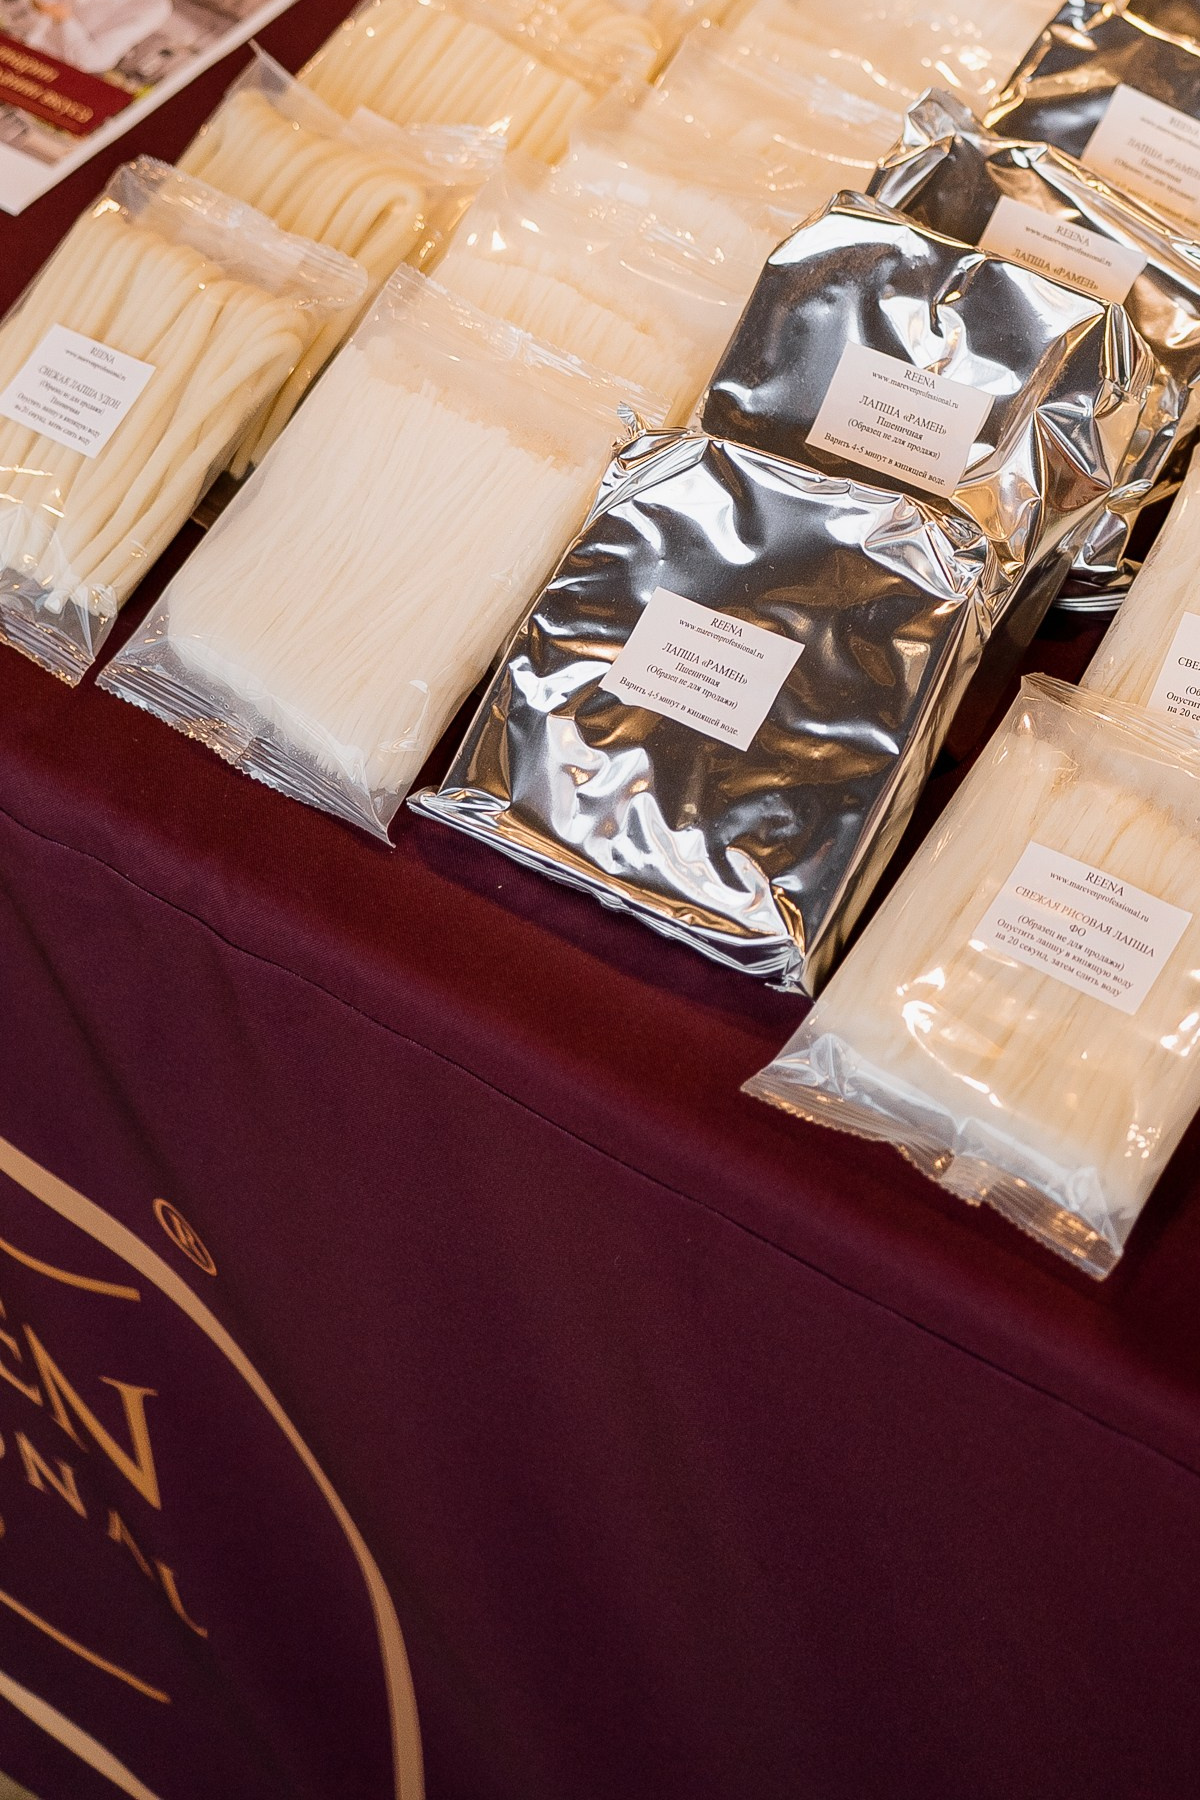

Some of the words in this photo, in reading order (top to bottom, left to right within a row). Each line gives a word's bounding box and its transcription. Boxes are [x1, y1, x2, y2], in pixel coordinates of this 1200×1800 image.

[1055, 225, 1090, 247] REENA
[1012, 248, 1051, 271] ЛАПША
[1053, 267, 1099, 290] «РАМЕН»
[90, 347, 116, 364] REENA
[69, 380, 99, 399] ЛАПША
[98, 393, 121, 409] УДОН
[872, 372, 959, 409] www.marevenprofessional.ru
[904, 369, 935, 389] REENA
[859, 395, 900, 418] ЛАПША
[903, 413, 947, 435] «РАМЕН»
[876, 416, 924, 440] Пшеничная
[824, 432, 850, 449] Варить
[851, 444, 864, 453] 4-5
[864, 450, 887, 463] минут
[894, 461, 928, 479] кипящей
[847, 418, 882, 438] (Образец
[892, 437, 906, 446] для
[906, 442, 941, 460] продажи)
[679, 619, 765, 659] www.marevenprofessional.ru
[710, 617, 743, 637] REENA
[662, 642, 700, 664] ЛАПША
[701, 659, 748, 685] «РАМЕН»
[675, 662, 721, 687] Пшеничная
[619, 676, 647, 695] Варить
[658, 696, 680, 709] минут
[686, 708, 721, 727] кипящей
[646, 664, 679, 683] (Образец
[678, 678, 688, 686] не
[687, 682, 702, 692] для
[701, 688, 738, 710] продажи)
[1167, 705, 1178, 714] на
[1179, 708, 1191, 717] 20
[1050, 872, 1150, 923] www.marevenprofessional.ru
[1085, 872, 1124, 896] REENA
[1015, 886, 1061, 911] СВЕЖАЯ
[1061, 905, 1113, 935] РИСОВАЯ
[1112, 930, 1155, 957] ЛАПША
[1069, 924, 1087, 937] ФО
[997, 918, 1035, 941] Опустить
[1036, 938, 1064, 955] лапшу
[1071, 955, 1112, 978] кипящую
[1112, 975, 1133, 989] воду
[1017, 915, 1056, 938] (Образец
[1056, 934, 1067, 942] не
[1067, 940, 1083, 950] для
[1083, 947, 1125, 972] продажи)
[995, 932, 1006, 941] на
[1007, 936, 1019, 946] 20
[1019, 943, 1049, 962] секунд,
[1051, 958, 1075, 973] затем
[1075, 970, 1099, 986] слить
[1100, 983, 1122, 997] воду
